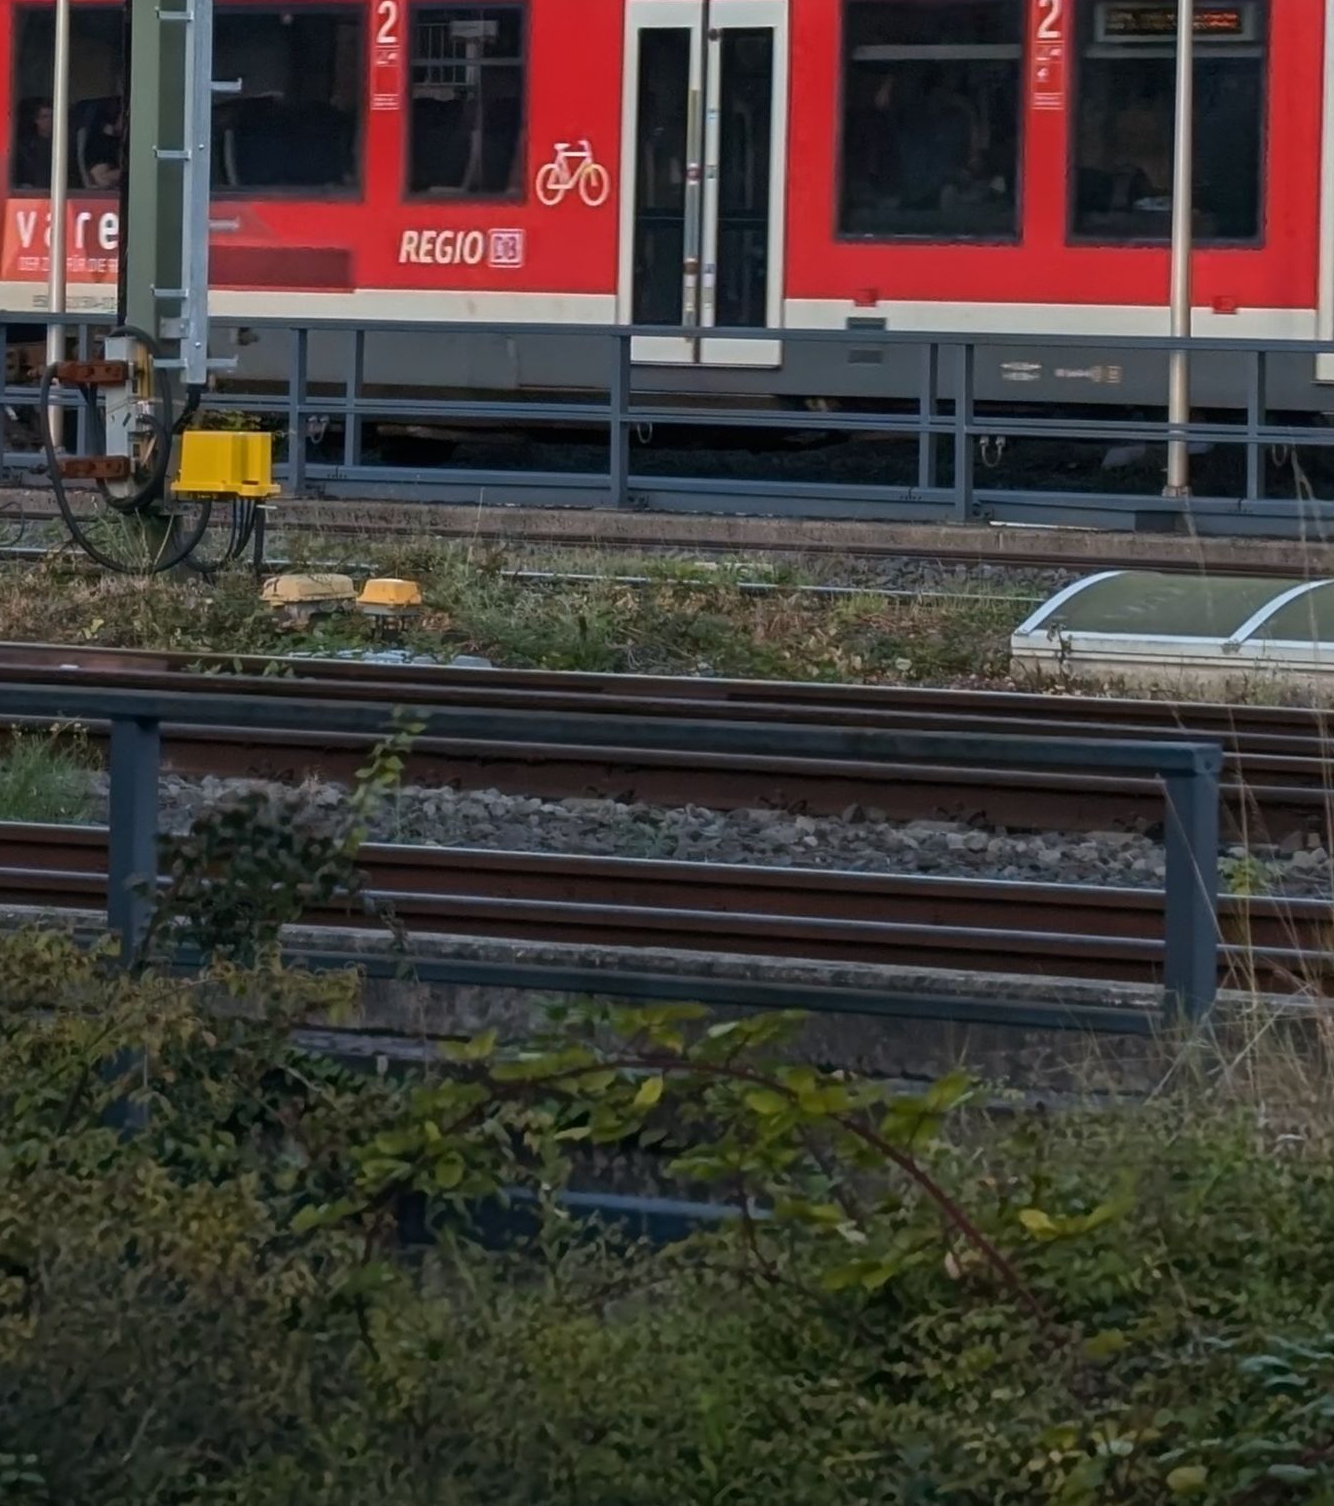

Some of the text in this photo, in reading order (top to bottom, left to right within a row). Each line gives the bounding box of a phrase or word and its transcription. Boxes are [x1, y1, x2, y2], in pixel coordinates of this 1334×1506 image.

[377, 0, 397, 43] 2
[16, 211, 119, 250] vre
[398, 230, 522, 264] REGIO DB
